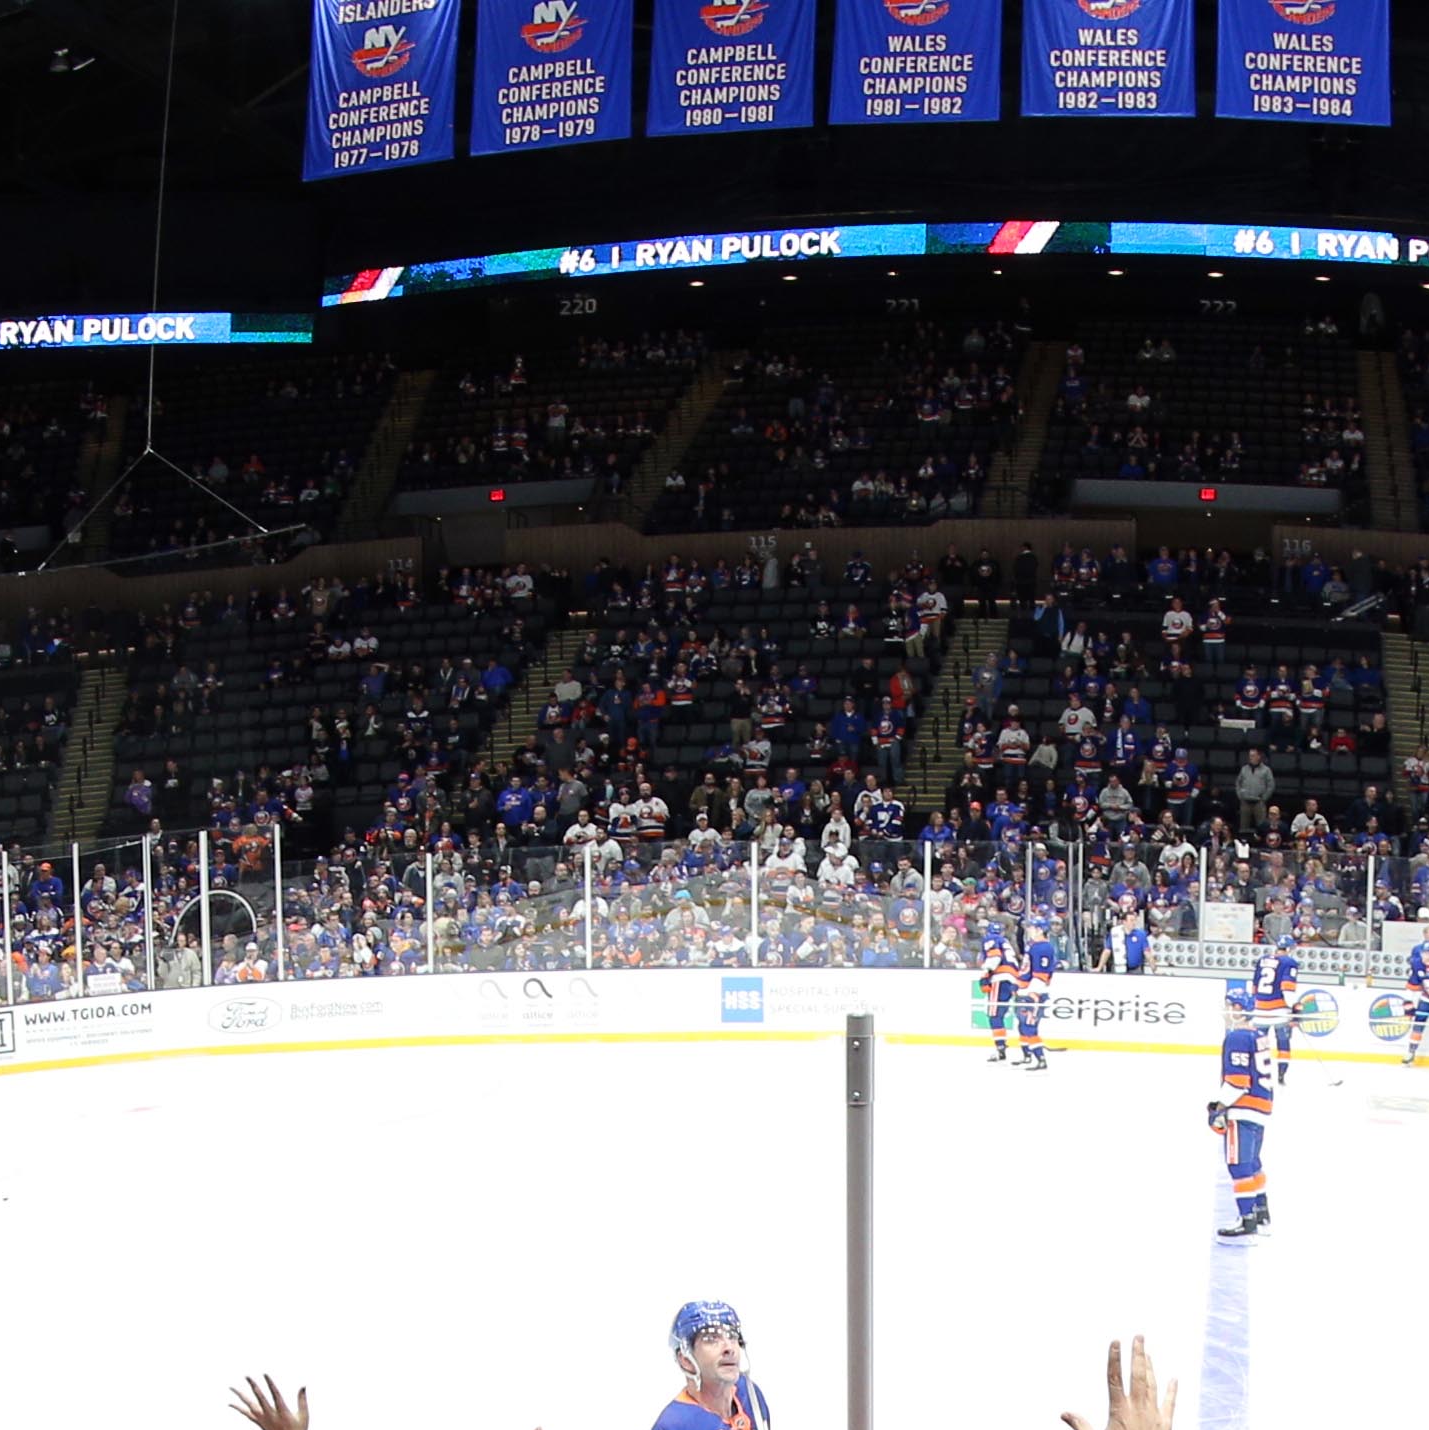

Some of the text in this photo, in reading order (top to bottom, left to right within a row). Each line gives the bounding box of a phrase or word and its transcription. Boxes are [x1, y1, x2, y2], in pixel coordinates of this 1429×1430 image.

[887, 34, 947, 53] WALES
[1078, 28, 1139, 47] WALES
[1273, 32, 1334, 53] WALES
[686, 43, 777, 66] CAMPBELL
[859, 54, 974, 75] CONFERENCE
[1049, 49, 1167, 68] CONFERENCE
[1245, 52, 1363, 75] CONFERENCE
[508, 58, 595, 84] CAMPBELL
[676, 63, 786, 86] CONFERENCE
[1054, 70, 1162, 89] CHAMPIONS
[339, 81, 421, 108] CAMPBELL
[498, 76, 605, 105] CONFERENCE
[679, 85, 780, 107] CHAMPIONS
[863, 76, 968, 96] CHAMPIONS
[1249, 73, 1357, 96] CHAMPIONS
[328, 98, 429, 130] CONFERENCE
[501, 97, 600, 124] CHAMPIONS
[331, 119, 423, 149] CHAMPIONS
[559, 230, 841, 274] #6 RYAN PULOCK
[1233, 229, 1275, 255] #6
[1317, 233, 1399, 261] RYAN
[559, 299, 598, 315] 220
[0, 318, 75, 346] RYAN
[82, 316, 196, 342] PULOCK
[750, 536, 777, 549] 115
[1283, 539, 1312, 552] 116
[1258, 967, 1275, 993] 2
[24, 1002, 153, 1027] WWW.TGIOA.COM
[1232, 1053, 1249, 1066] 55
